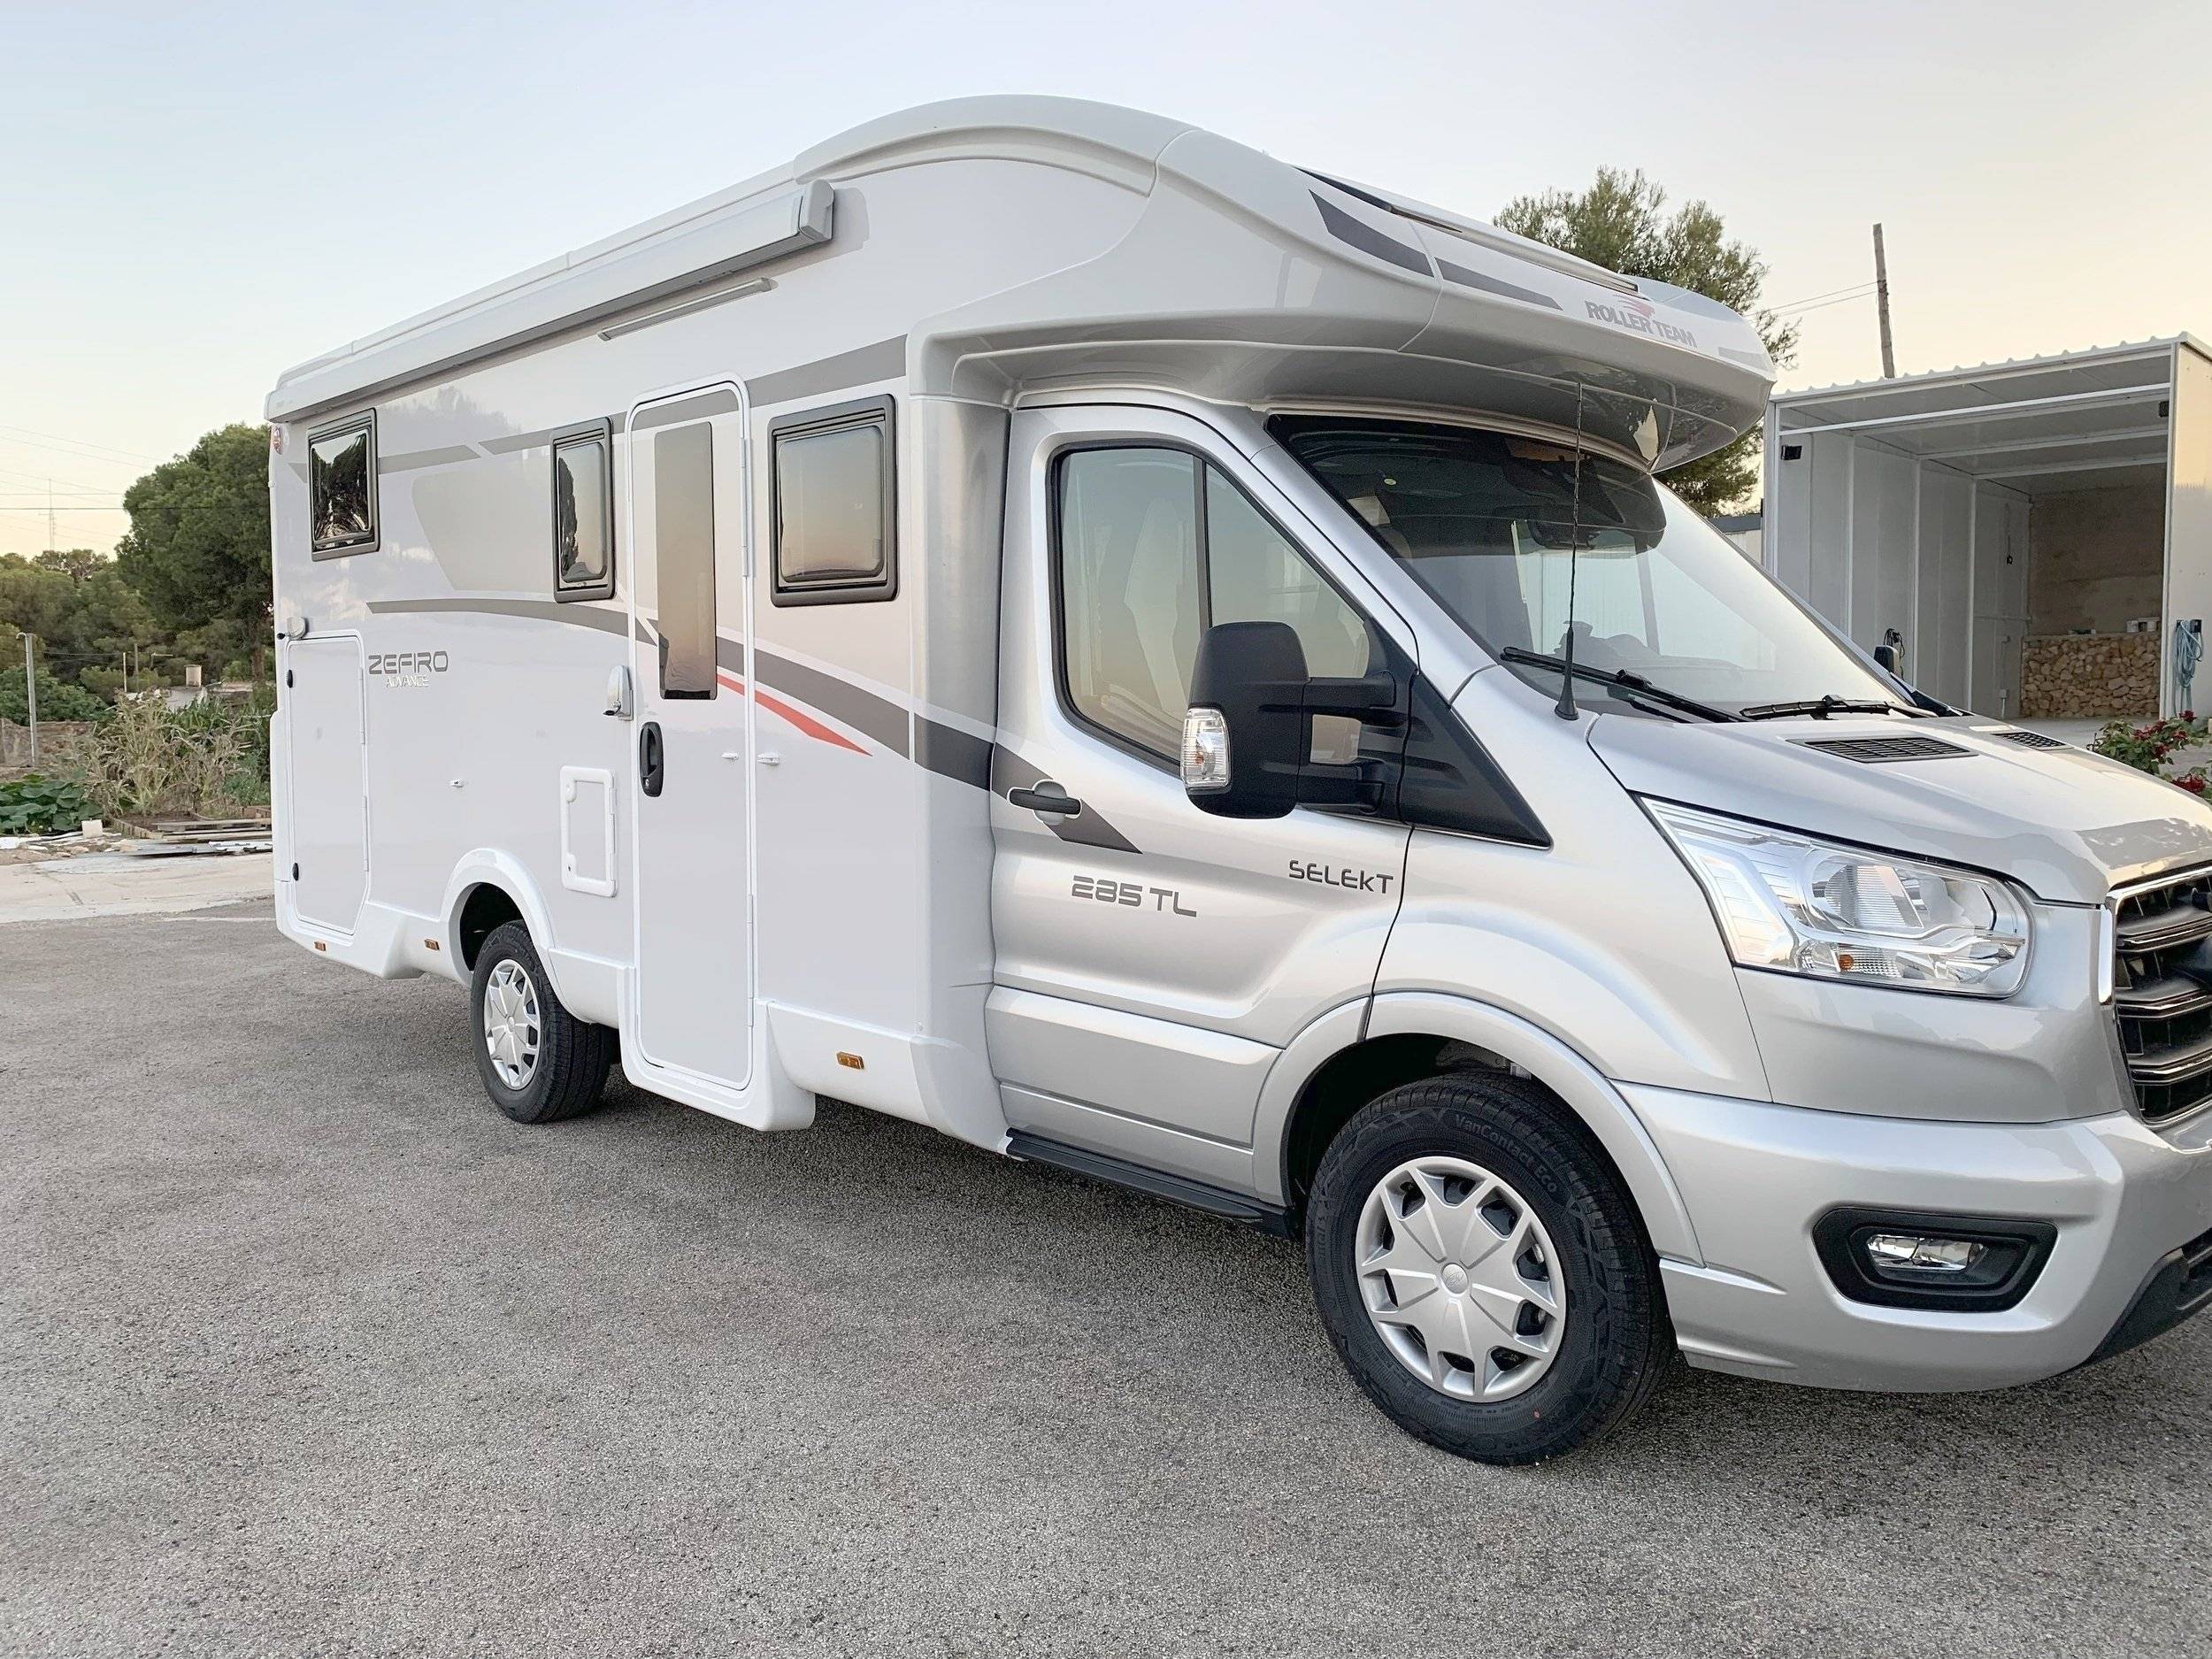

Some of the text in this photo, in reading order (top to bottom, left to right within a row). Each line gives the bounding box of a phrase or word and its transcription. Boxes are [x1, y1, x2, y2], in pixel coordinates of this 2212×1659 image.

[1584, 300, 1698, 349] ROLLER TEAM
[368, 650, 449, 675] ZEFIRO
[1071, 874, 1197, 918] 285 TL
[1288, 859, 1394, 895] SELEKT
[1455, 1114, 1534, 1169] VanContact
